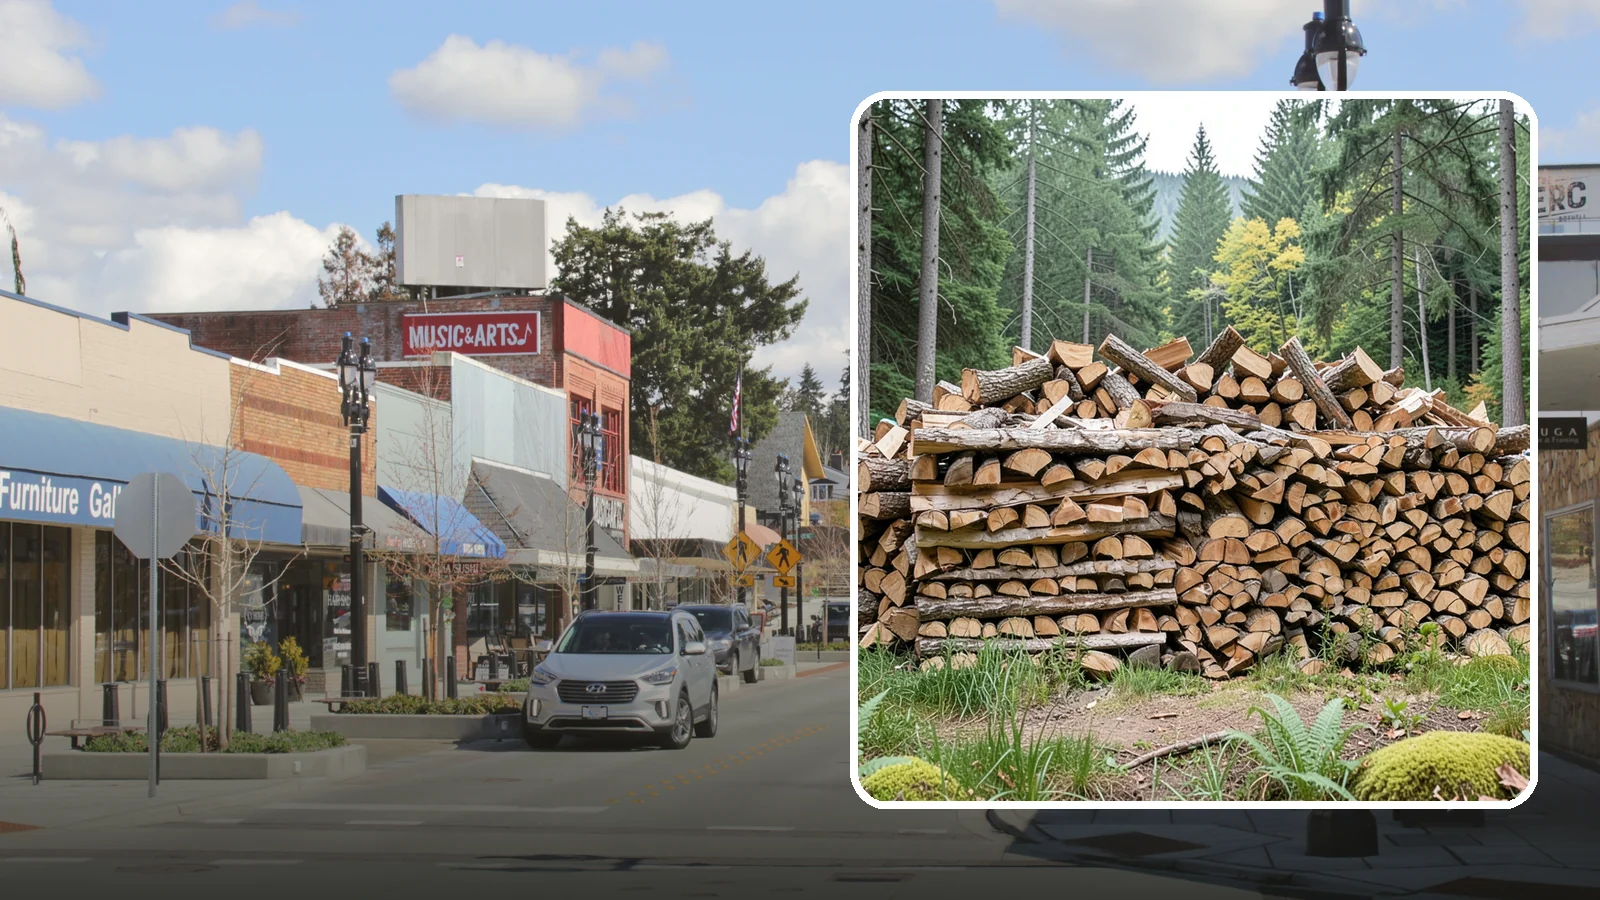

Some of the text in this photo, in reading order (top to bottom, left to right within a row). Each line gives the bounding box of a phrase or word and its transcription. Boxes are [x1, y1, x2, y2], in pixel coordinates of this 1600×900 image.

[0, 471, 121, 519] Furniture Gal
[453, 563, 479, 574] SUSHI
